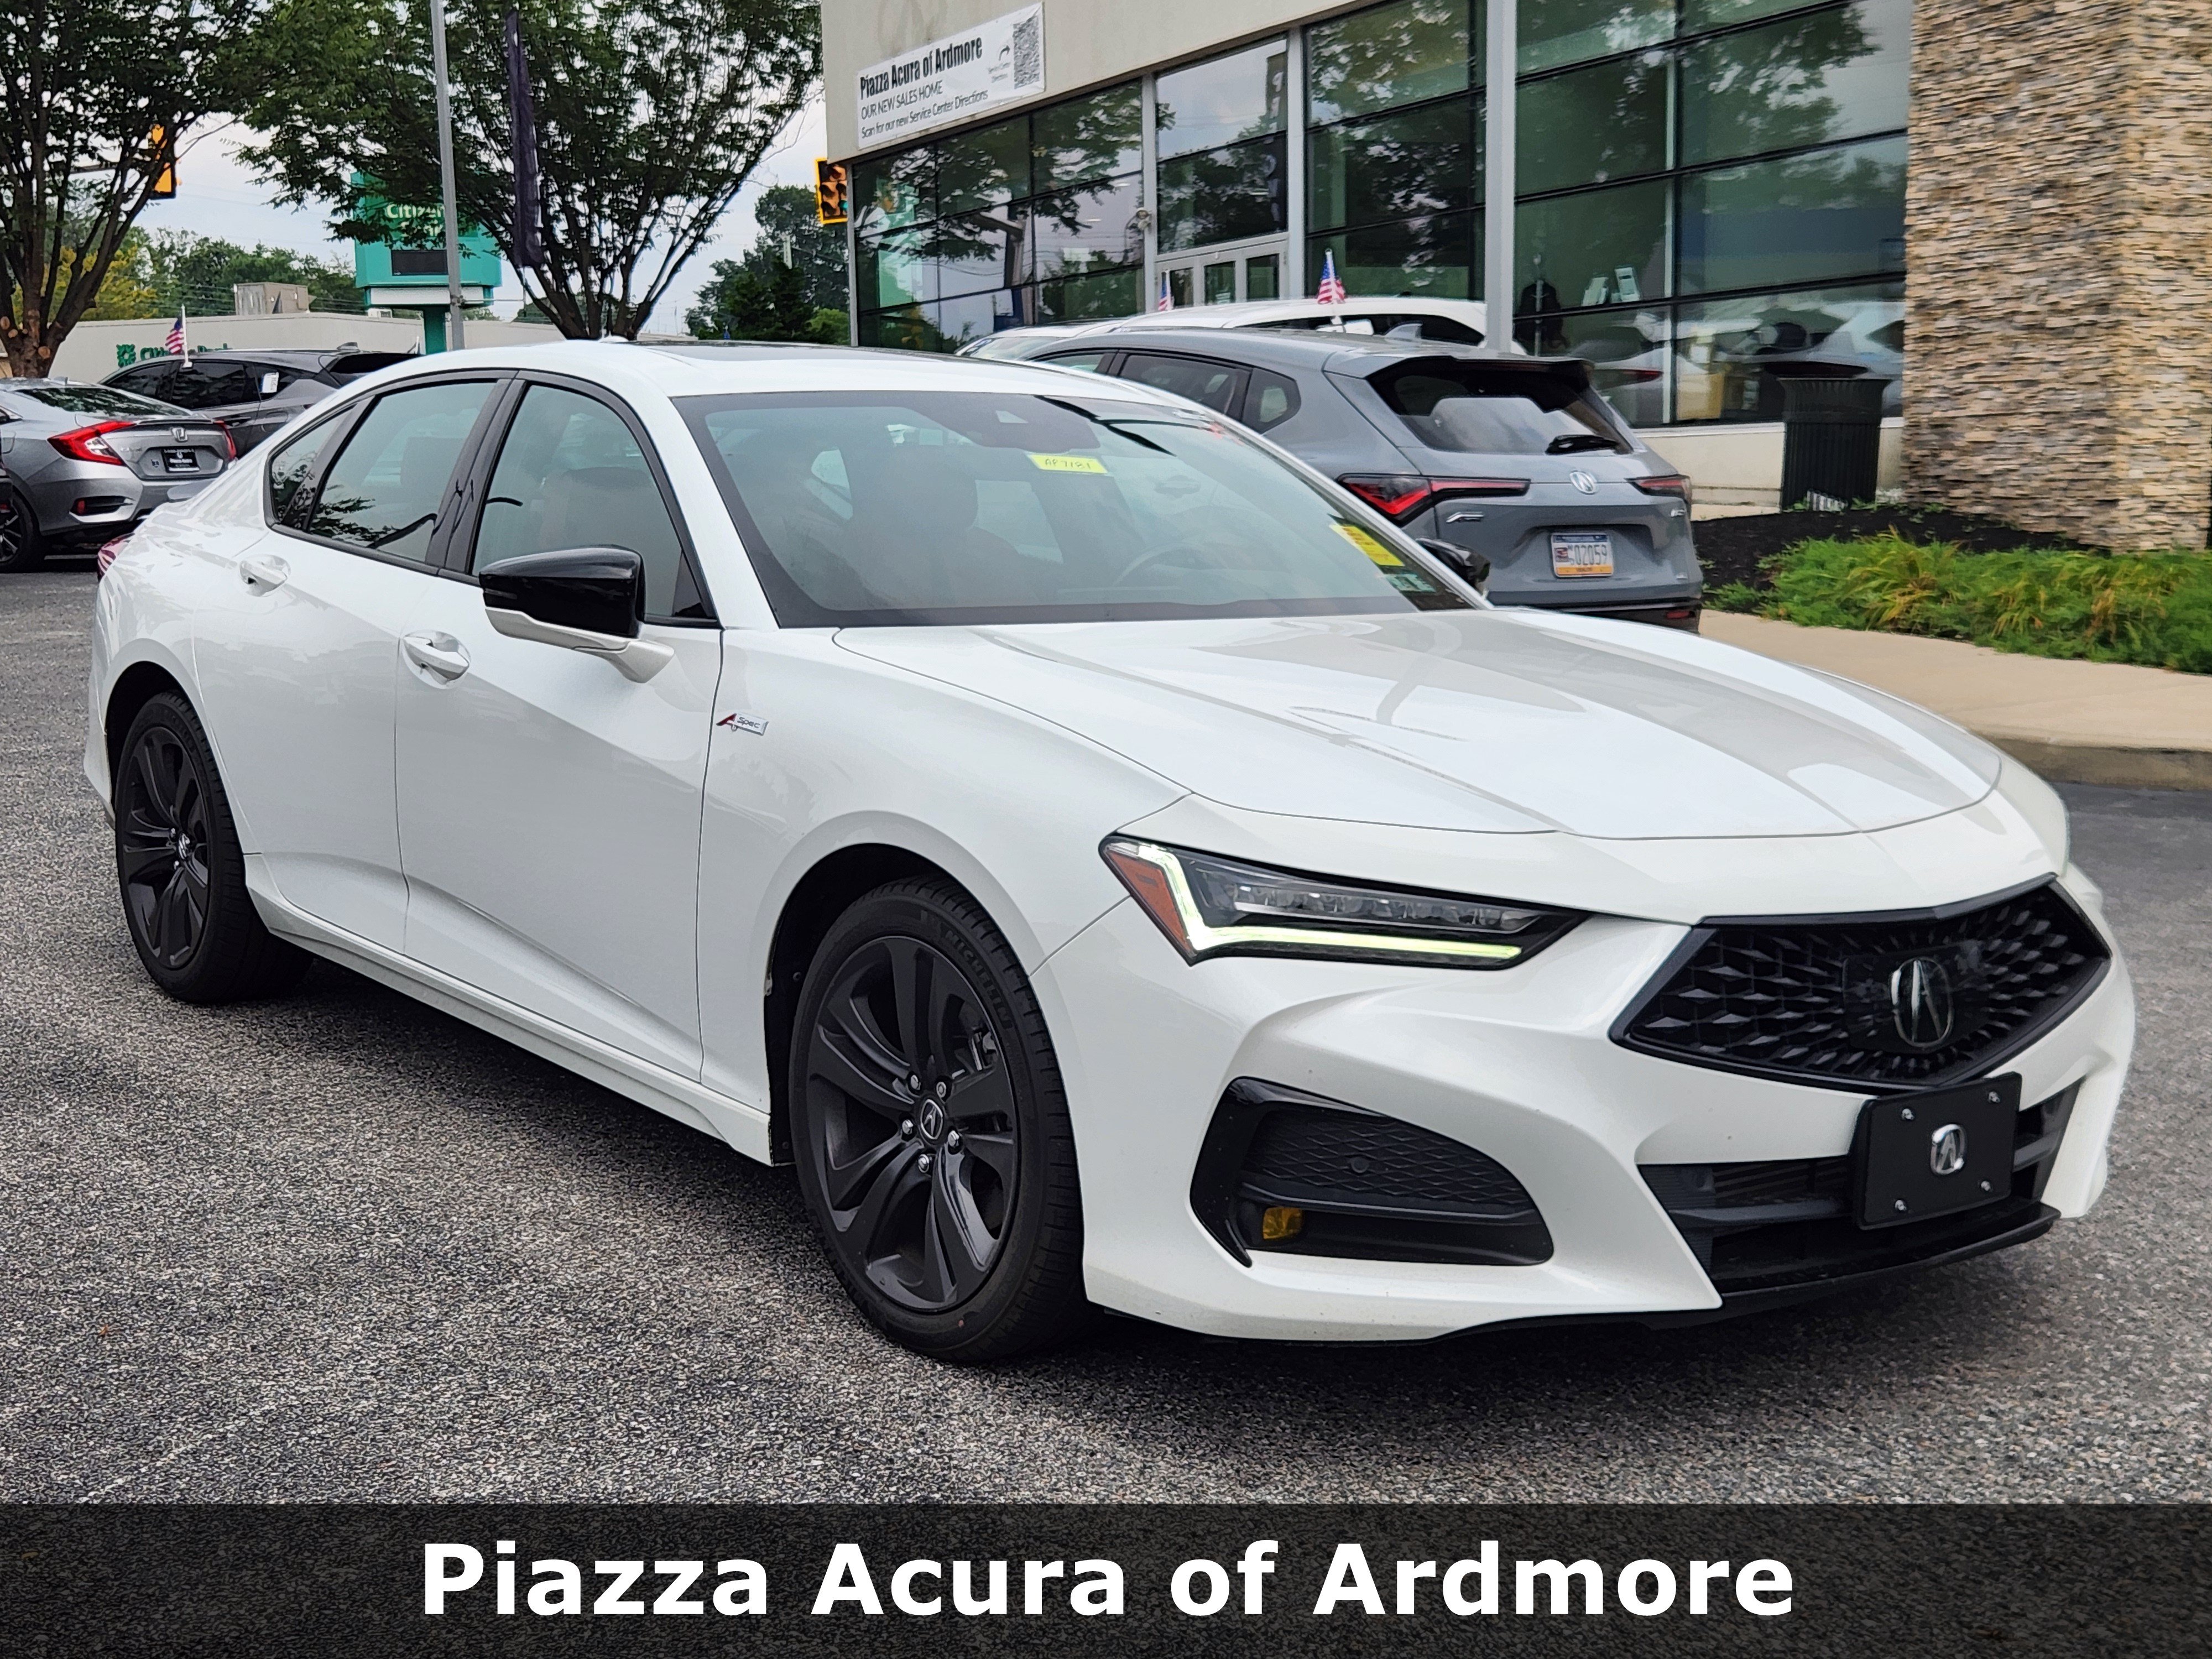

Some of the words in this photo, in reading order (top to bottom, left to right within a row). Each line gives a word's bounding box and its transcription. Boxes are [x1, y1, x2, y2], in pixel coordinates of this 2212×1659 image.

[860, 72, 889, 100] Piazza
[891, 64, 920, 90] Acura
[923, 50, 933, 78] of
[935, 37, 983, 74] Ardmore
[862, 103, 877, 120] OUR
[878, 96, 896, 115] NEW
[896, 88, 917, 108] SALES
[919, 80, 943, 101] HOME
[862, 127, 875, 139] Scan
[910, 107, 931, 123] Service
[932, 103, 953, 116] Center
[955, 90, 988, 109] Directions
